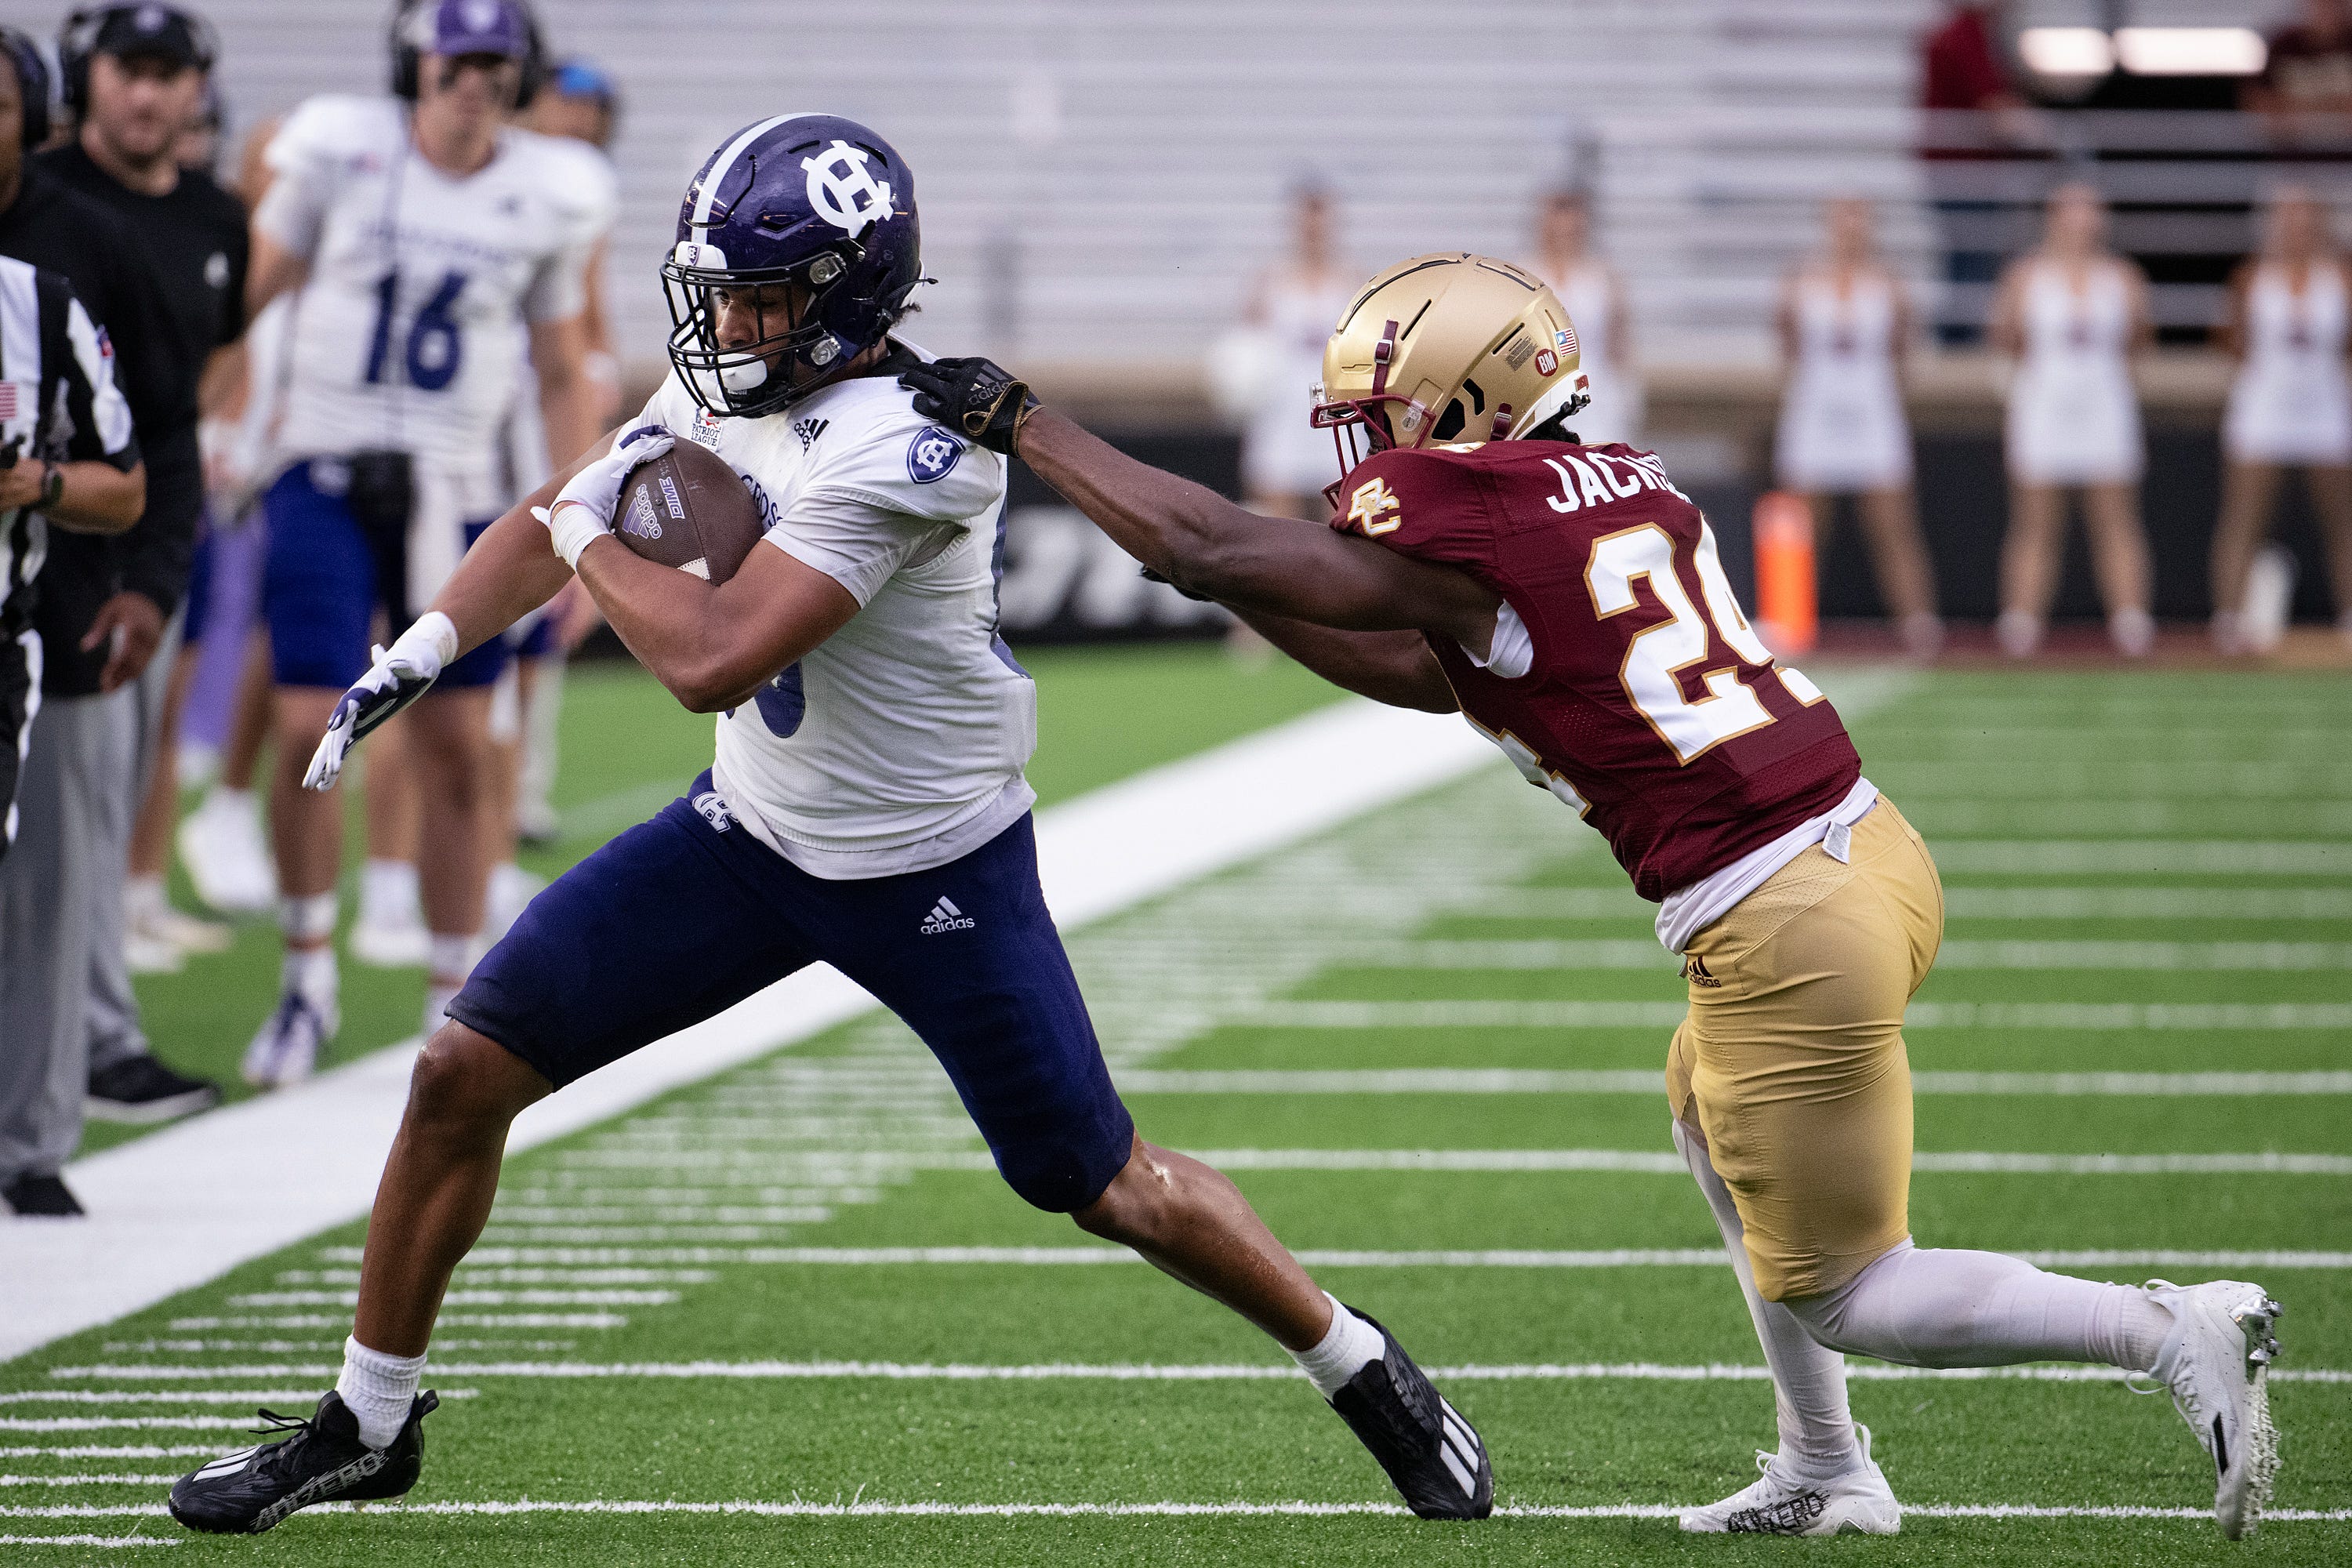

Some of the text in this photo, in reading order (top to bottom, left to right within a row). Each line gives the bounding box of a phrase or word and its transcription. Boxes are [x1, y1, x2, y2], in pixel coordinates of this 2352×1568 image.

[365, 269, 466, 391] 16
[1537, 351, 1556, 374] BM
[969, 382, 1010, 405] adida
[691, 432, 718, 447] LEAGUE
[692, 423, 720, 438] PATRIOT
[794, 423, 811, 457] adda
[659, 476, 685, 519] DIME
[635, 483, 662, 539] adidas
[920, 917, 975, 935] adidas
